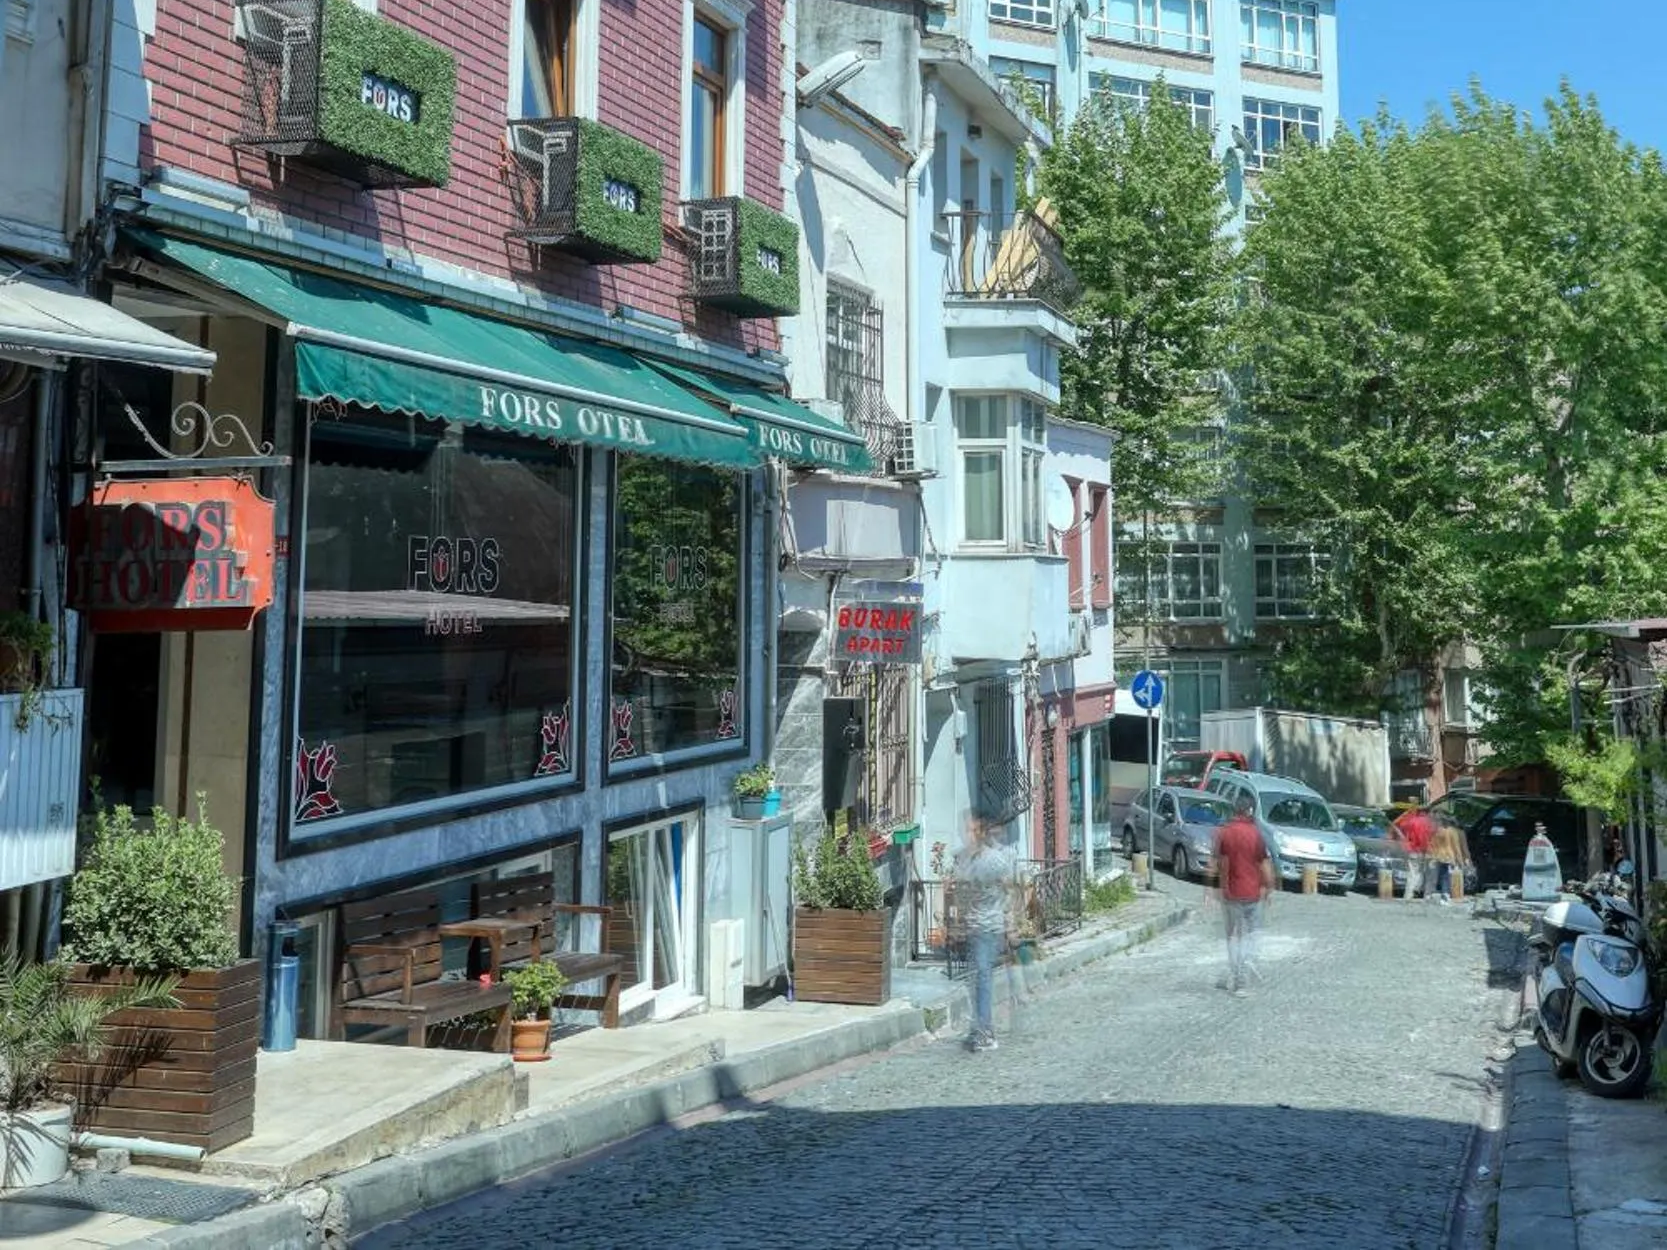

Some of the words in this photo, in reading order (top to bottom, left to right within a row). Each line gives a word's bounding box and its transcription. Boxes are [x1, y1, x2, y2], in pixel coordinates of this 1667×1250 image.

[361, 76, 412, 122] FORS
[602, 181, 636, 212] FORS
[480, 386, 562, 430] FORS
[577, 407, 656, 446] OTEL
[759, 424, 803, 454] FORS
[810, 437, 849, 466] OTEL
[90, 503, 224, 551] FORS
[75, 556, 243, 604] HOTEL
[406, 535, 500, 592] FORS
[649, 544, 707, 590] FORS
[426, 610, 483, 635] HOTEL
[837, 604, 915, 631] BURAK
[846, 635, 905, 654] APART
